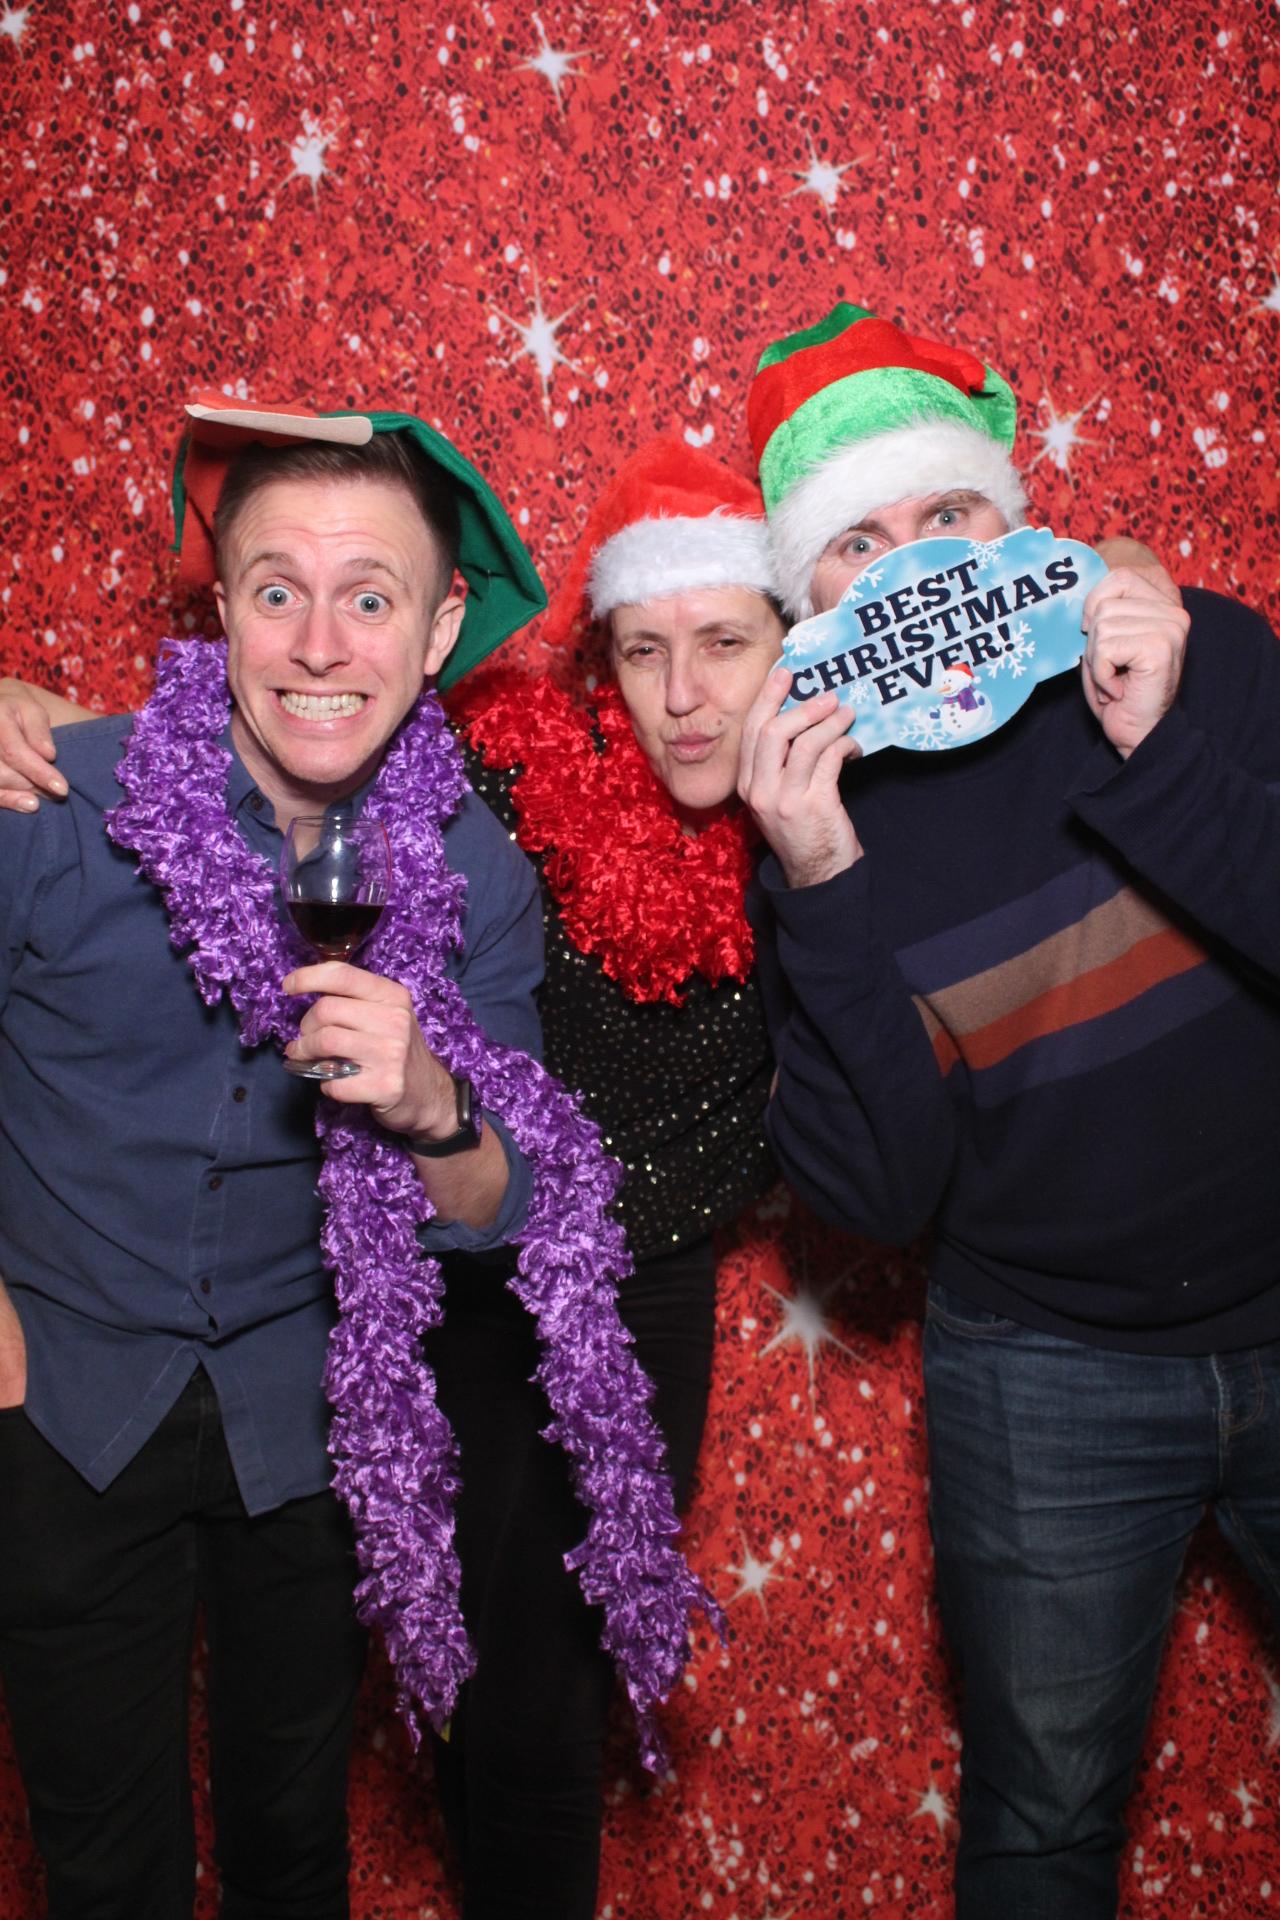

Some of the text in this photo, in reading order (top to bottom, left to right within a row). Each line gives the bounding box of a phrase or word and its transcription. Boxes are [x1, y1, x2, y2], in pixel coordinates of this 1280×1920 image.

[789, 556, 1079, 701] CHRISTMAS
[855, 559, 978, 637] BEST
[872, 622, 1015, 705] EVER!
